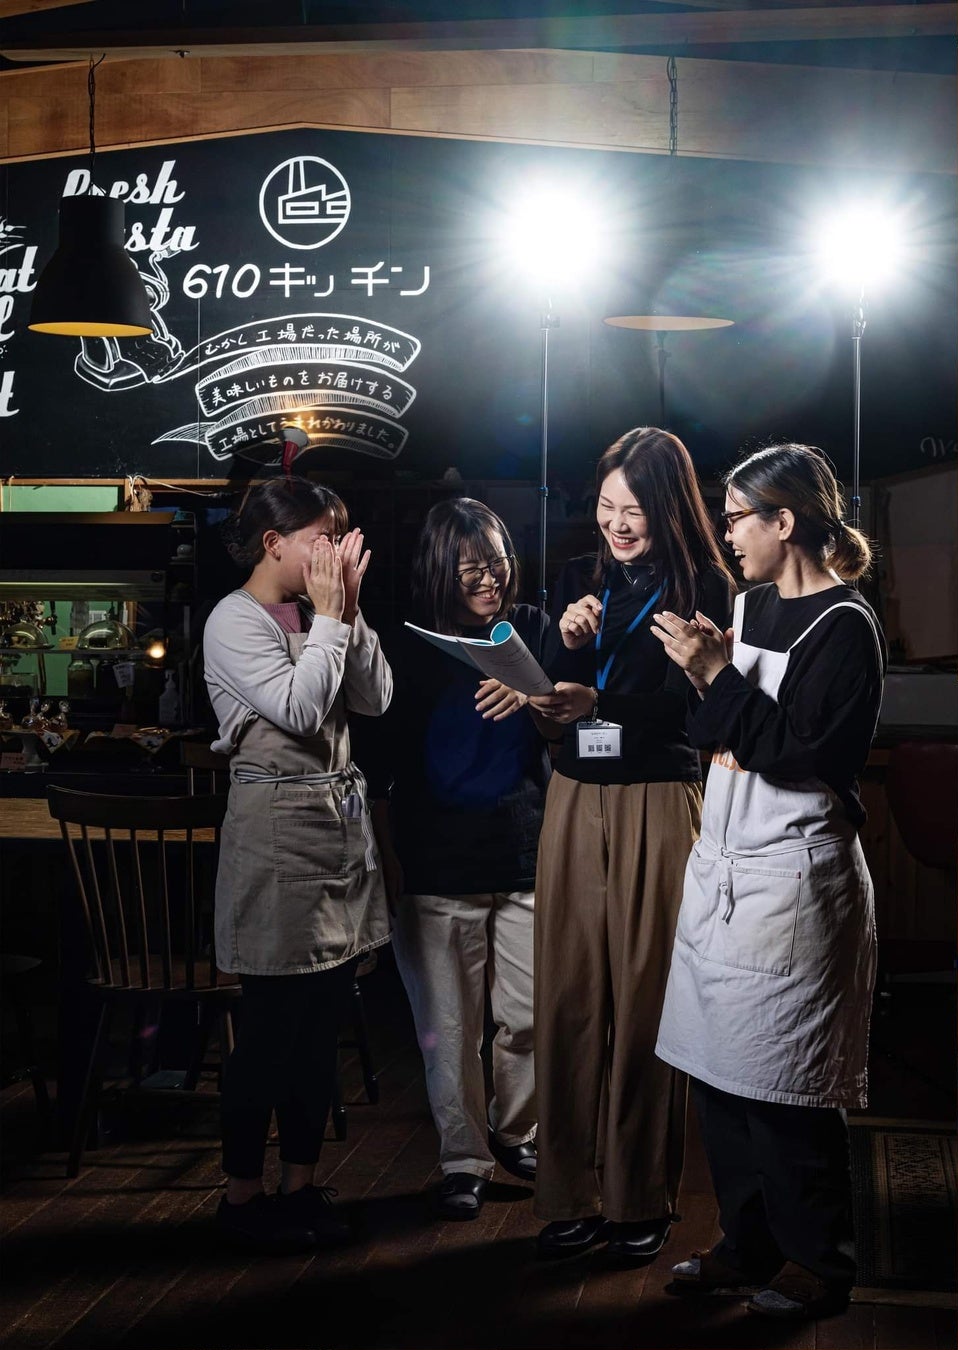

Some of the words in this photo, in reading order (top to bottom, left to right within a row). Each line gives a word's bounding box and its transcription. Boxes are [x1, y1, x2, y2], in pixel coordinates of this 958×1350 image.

[124, 207, 200, 251] sta
[182, 261, 431, 299] 610キッチン
[211, 370, 393, 407] 美味しいものをお届けする
